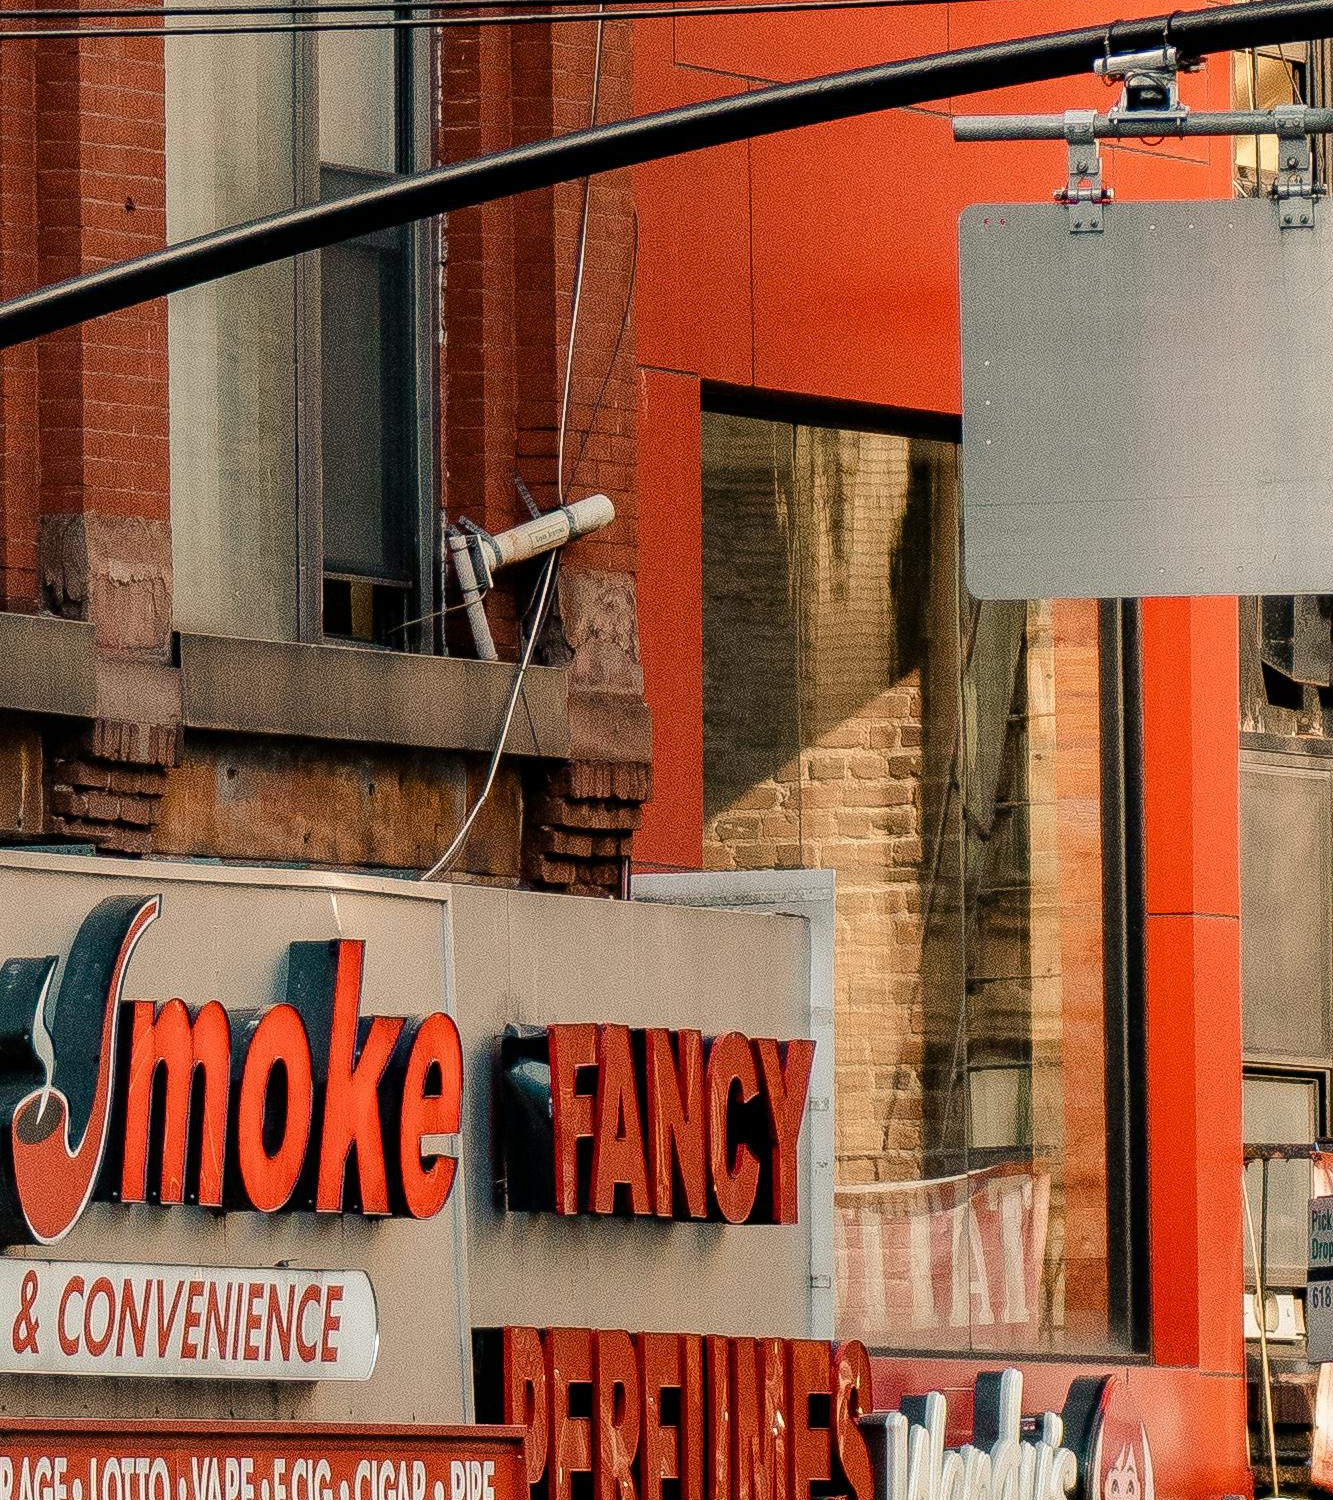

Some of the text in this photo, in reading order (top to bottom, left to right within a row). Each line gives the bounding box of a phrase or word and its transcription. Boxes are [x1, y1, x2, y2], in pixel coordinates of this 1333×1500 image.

[548, 1022, 816, 1225] FANCY
[1311, 1208, 1332, 1231] Pick
[11, 1269, 345, 1364] & CONVENIENCE
[1311, 1286, 1331, 1309] 618
